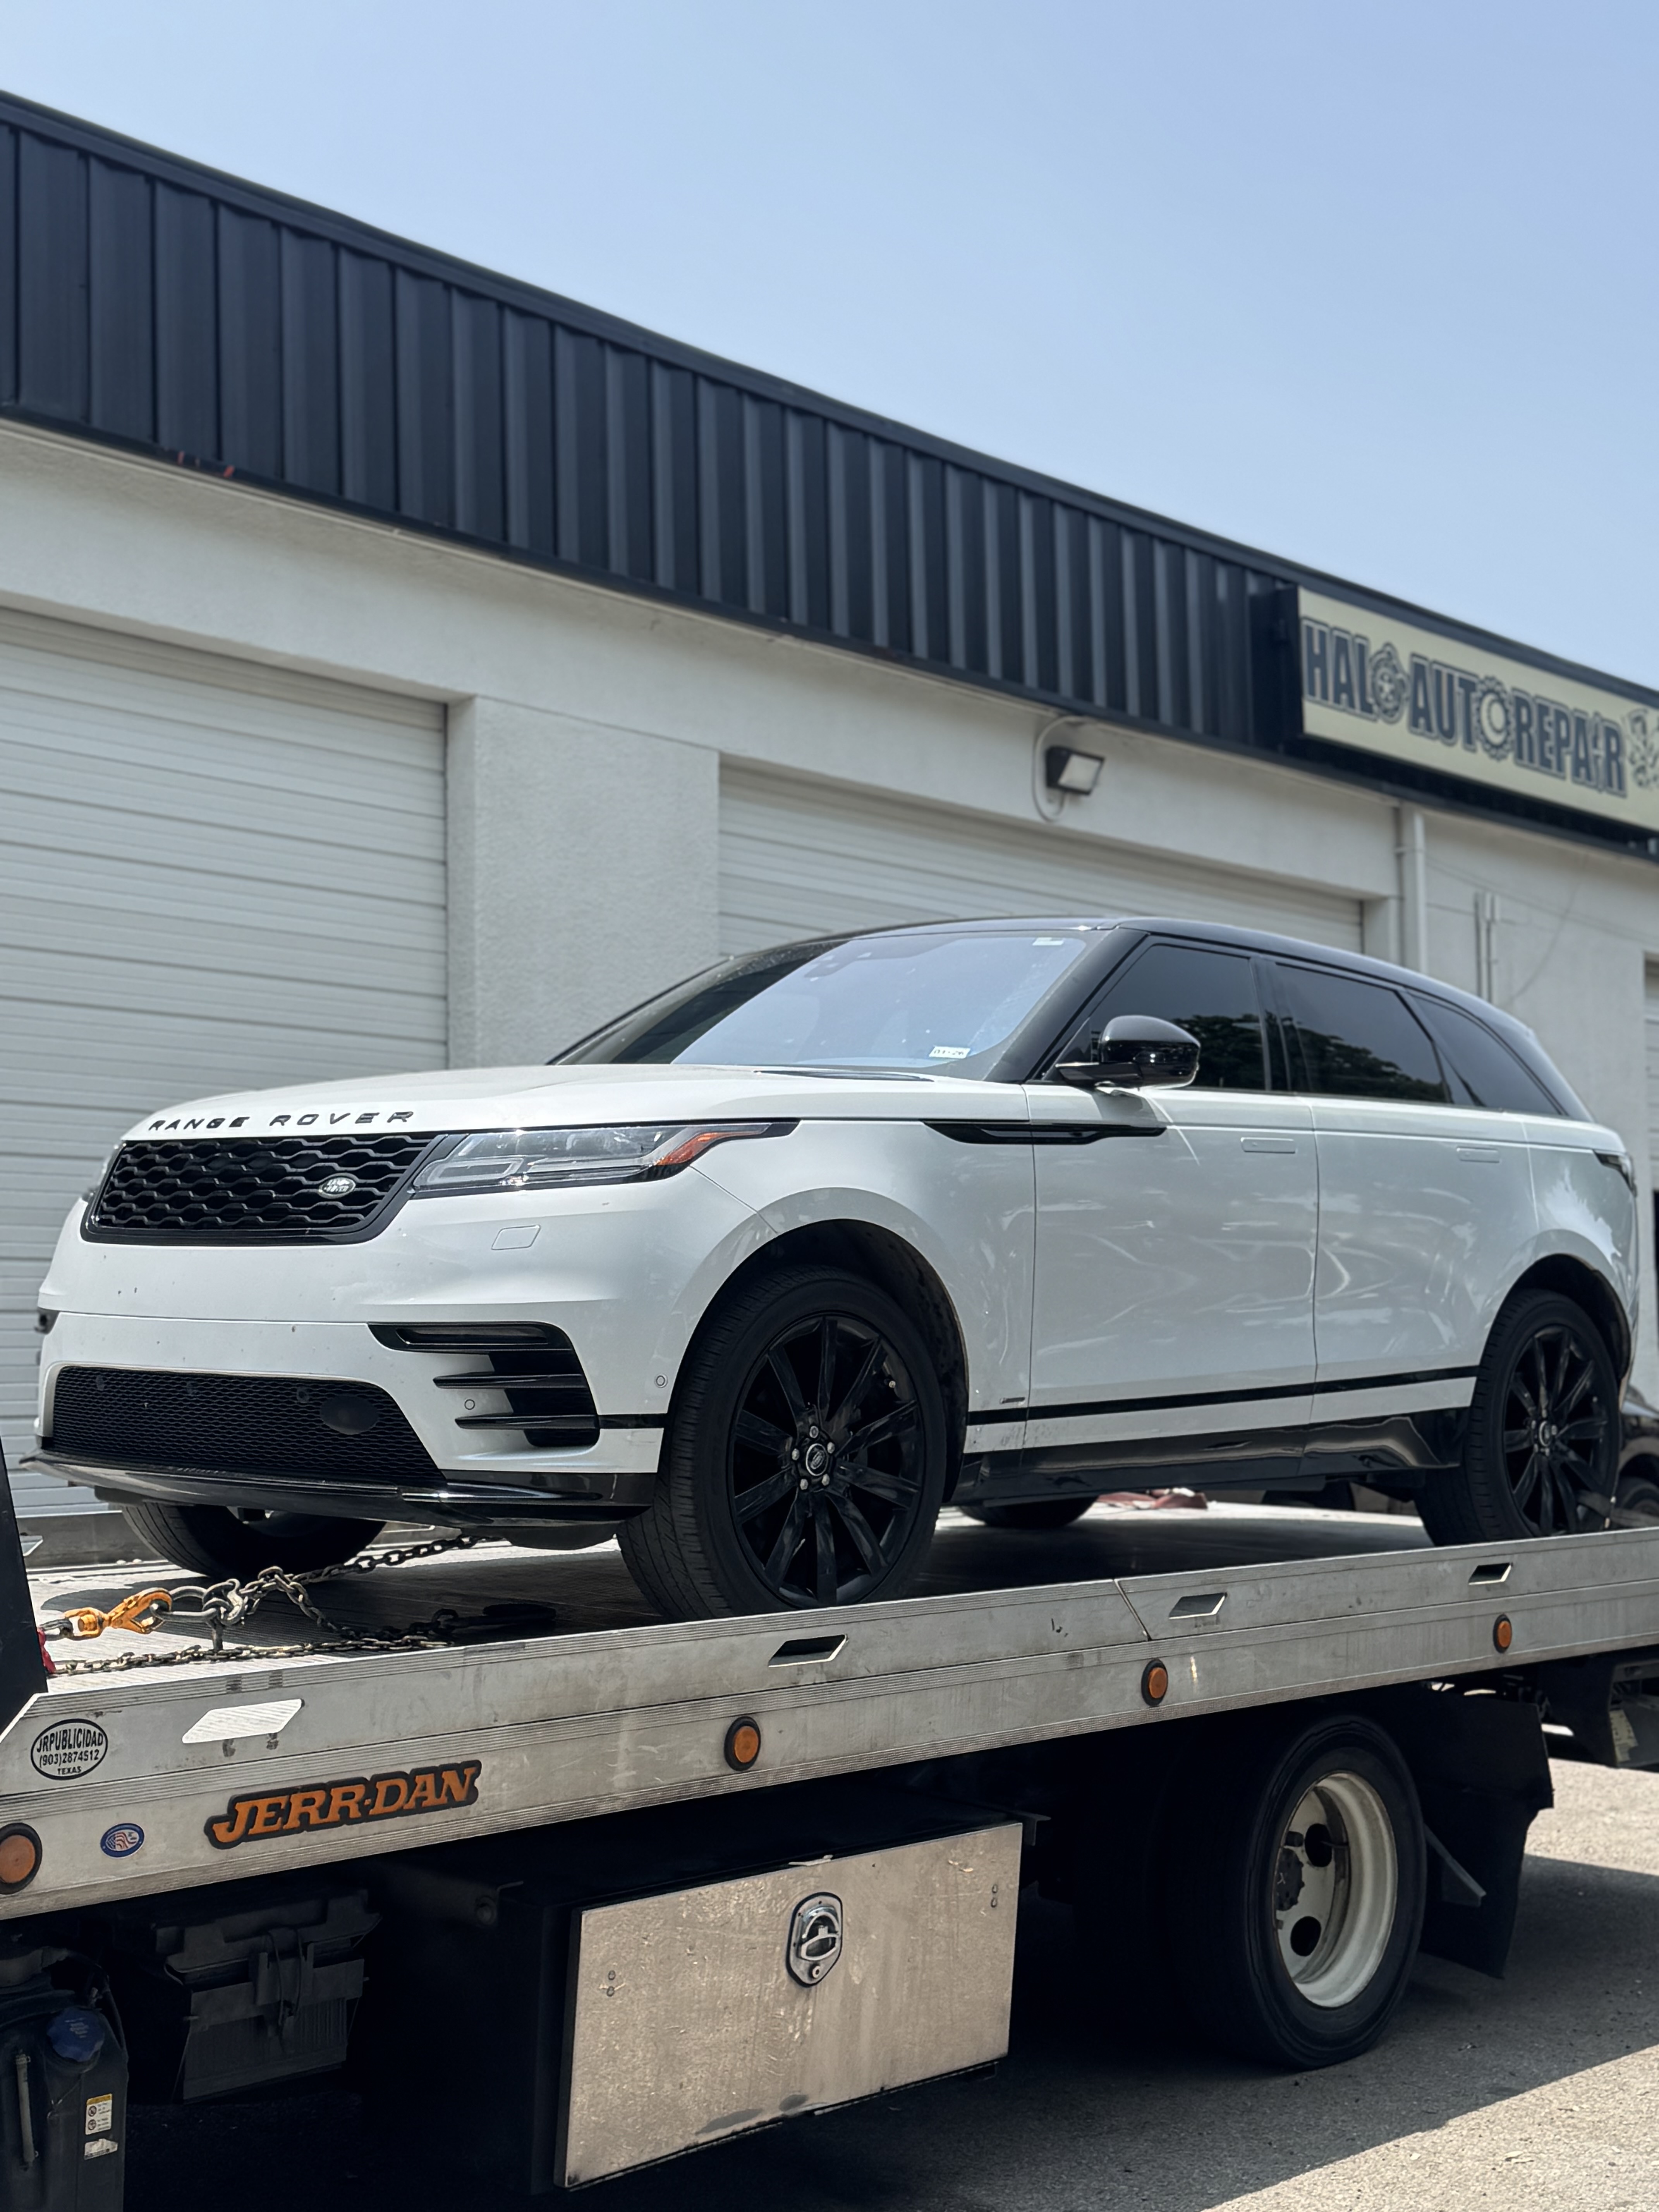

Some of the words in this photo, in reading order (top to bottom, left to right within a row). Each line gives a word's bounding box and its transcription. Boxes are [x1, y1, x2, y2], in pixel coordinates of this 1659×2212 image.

[1408, 651, 1513, 761] AUTO
[1511, 687, 1628, 797] REPAIR
[148, 1116, 250, 1131] RANGE
[269, 1111, 414, 1127] ROVER
[37, 1729, 103, 1752] JRPUBLICIDAD
[40, 1749, 99, 1768] (903)2874512
[58, 1766, 82, 1775] TEXAS
